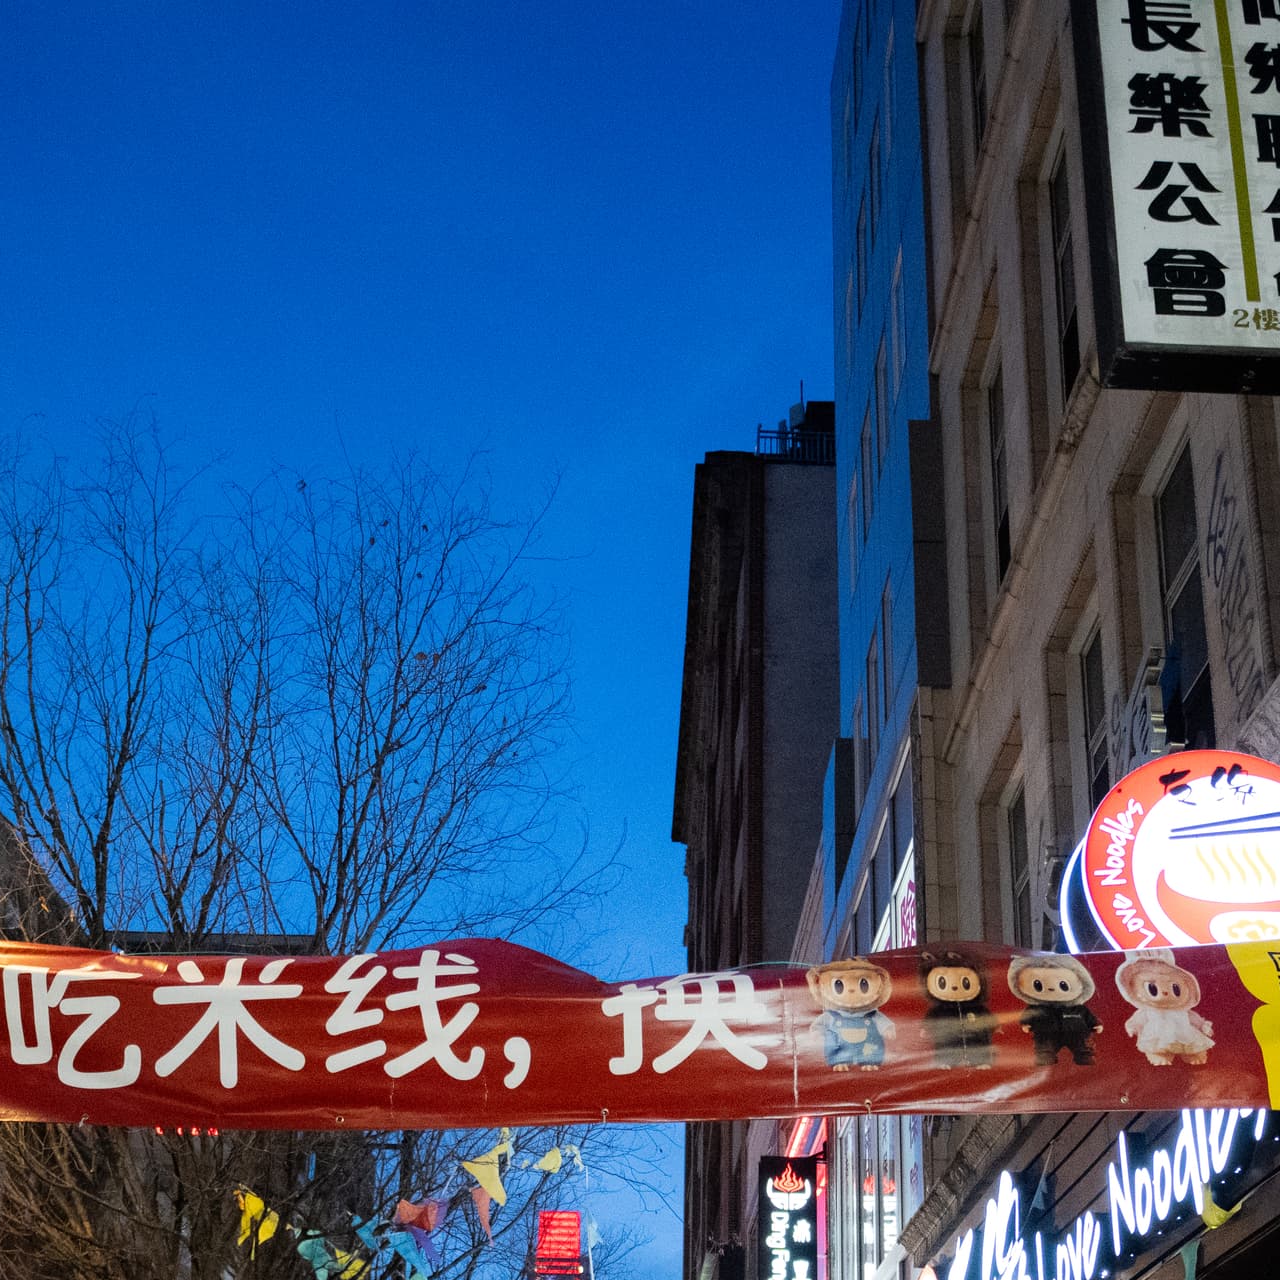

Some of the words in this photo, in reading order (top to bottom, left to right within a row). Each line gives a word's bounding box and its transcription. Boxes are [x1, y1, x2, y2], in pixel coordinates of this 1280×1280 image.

[1093, 798, 1144, 886] Noodles
[1112, 892, 1157, 949] Love
[1108, 1109, 1267, 1257] Noodle
[766, 1211, 790, 1248] Ding
